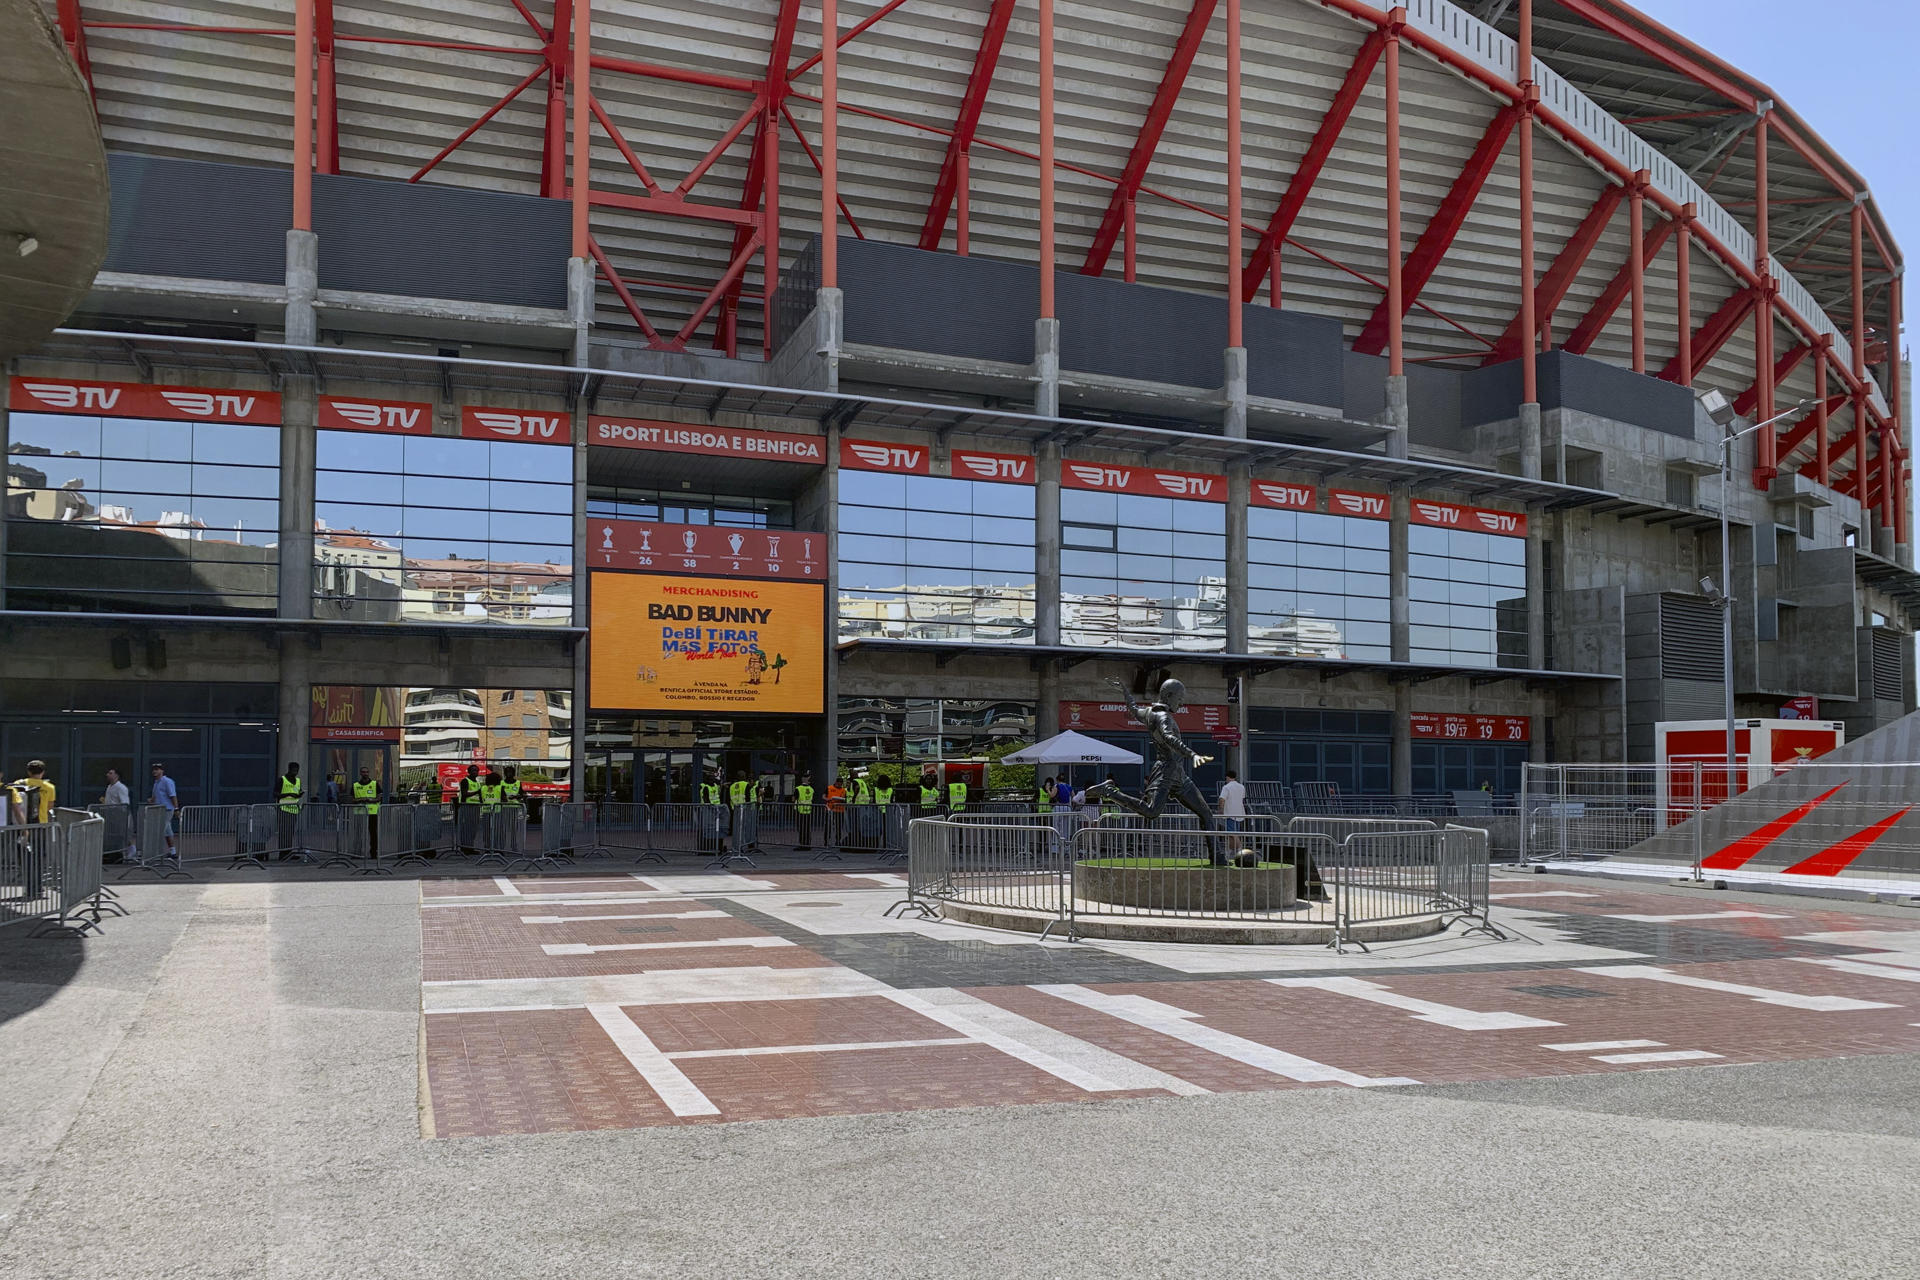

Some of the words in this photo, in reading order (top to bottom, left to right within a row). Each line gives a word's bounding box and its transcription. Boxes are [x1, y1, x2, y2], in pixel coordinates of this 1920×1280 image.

[23, 384, 120, 409] BTV
[161, 391, 255, 417] BTV
[332, 402, 420, 428] BTV
[474, 413, 559, 437] BTV
[599, 423, 660, 442] SPORT
[664, 430, 729, 449] LISBOA
[733, 436, 742, 450] E
[746, 437, 819, 457] BENFICA
[850, 445, 920, 469] BTV
[961, 456, 1026, 478] BTV
[1071, 466, 1130, 487] BTV
[1155, 474, 1212, 495] BTV
[1258, 485, 1309, 505] BTV
[1335, 494, 1385, 514] BTV
[1416, 504, 1459, 523] BTV
[1475, 512, 1517, 531] BTV
[604, 554, 611, 563] 1
[639, 556, 652, 566] 26
[683, 559, 697, 568] 38
[732, 561, 740, 570] 2
[768, 563, 780, 572] 10
[804, 565, 811, 574] 8
[663, 586, 759, 599] MERCHANDISING
[648, 603, 693, 621] BAD
[697, 605, 772, 624] BUNNY
[706, 628, 758, 642] TiRAR
[685, 650, 715, 661] World
[716, 648, 738, 659] Tour
[1100, 704, 1127, 713] CAMPOS
[1480, 725, 1493, 738] 19
[1509, 726, 1521, 739] 20
